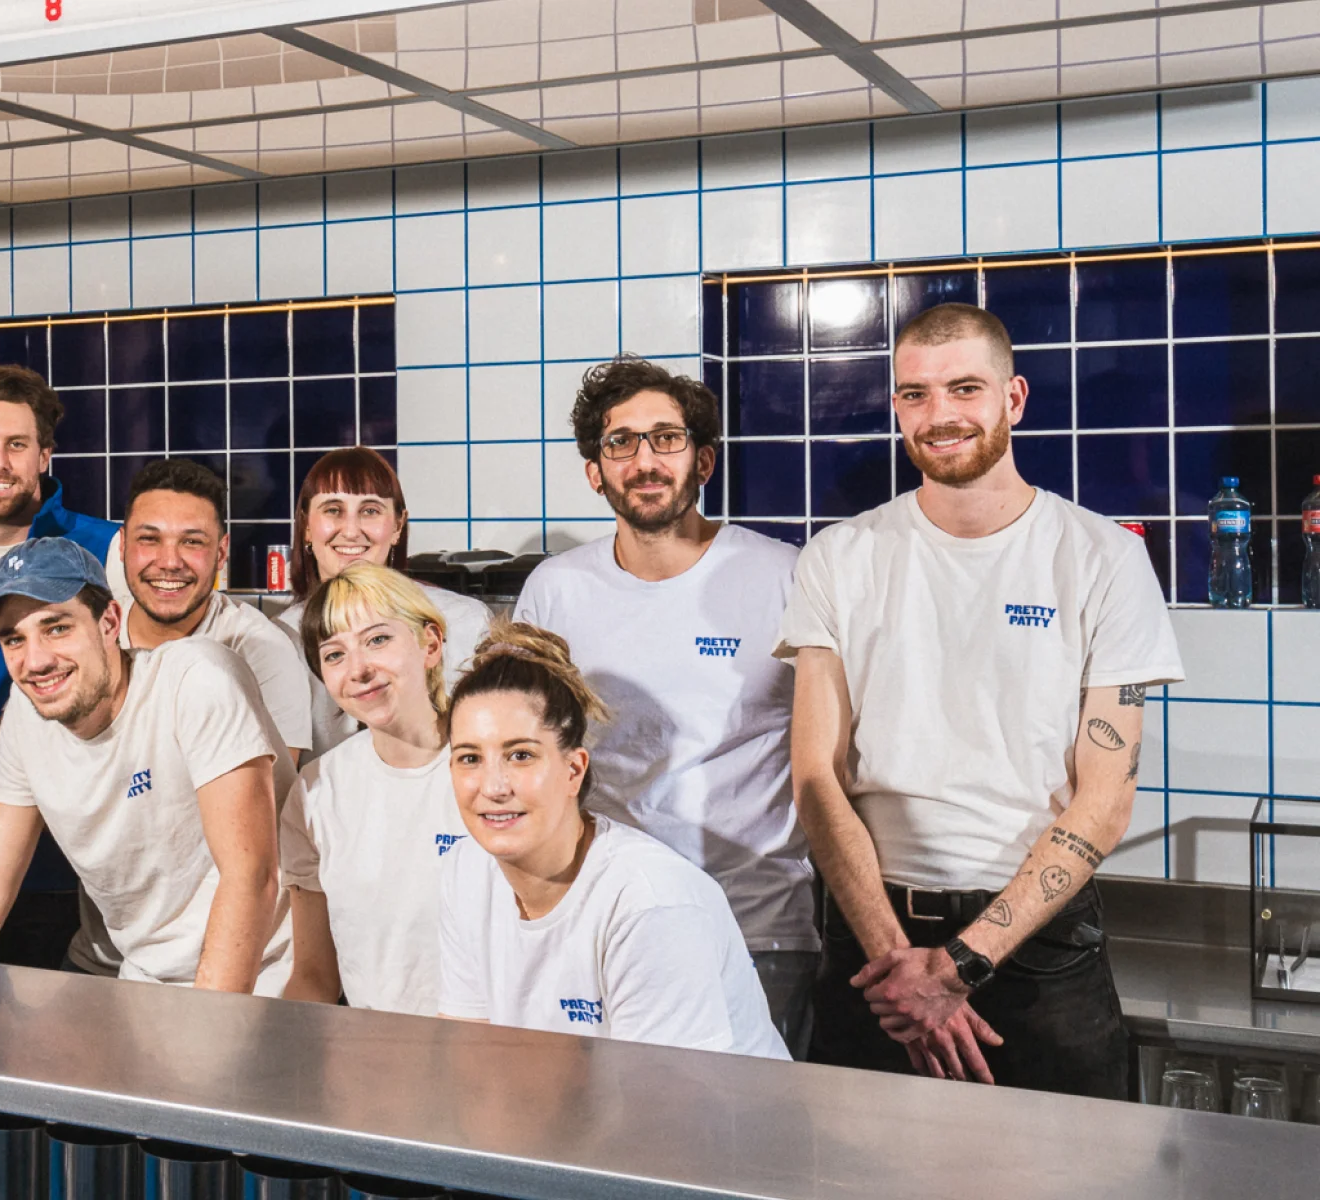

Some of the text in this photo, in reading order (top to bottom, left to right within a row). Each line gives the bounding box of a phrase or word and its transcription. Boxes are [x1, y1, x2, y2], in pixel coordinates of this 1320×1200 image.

[1005, 604, 1056, 618] PRETTY
[1009, 615, 1051, 628] PATTY
[695, 637, 741, 648] PRETTY
[699, 647, 737, 657] PATTY
